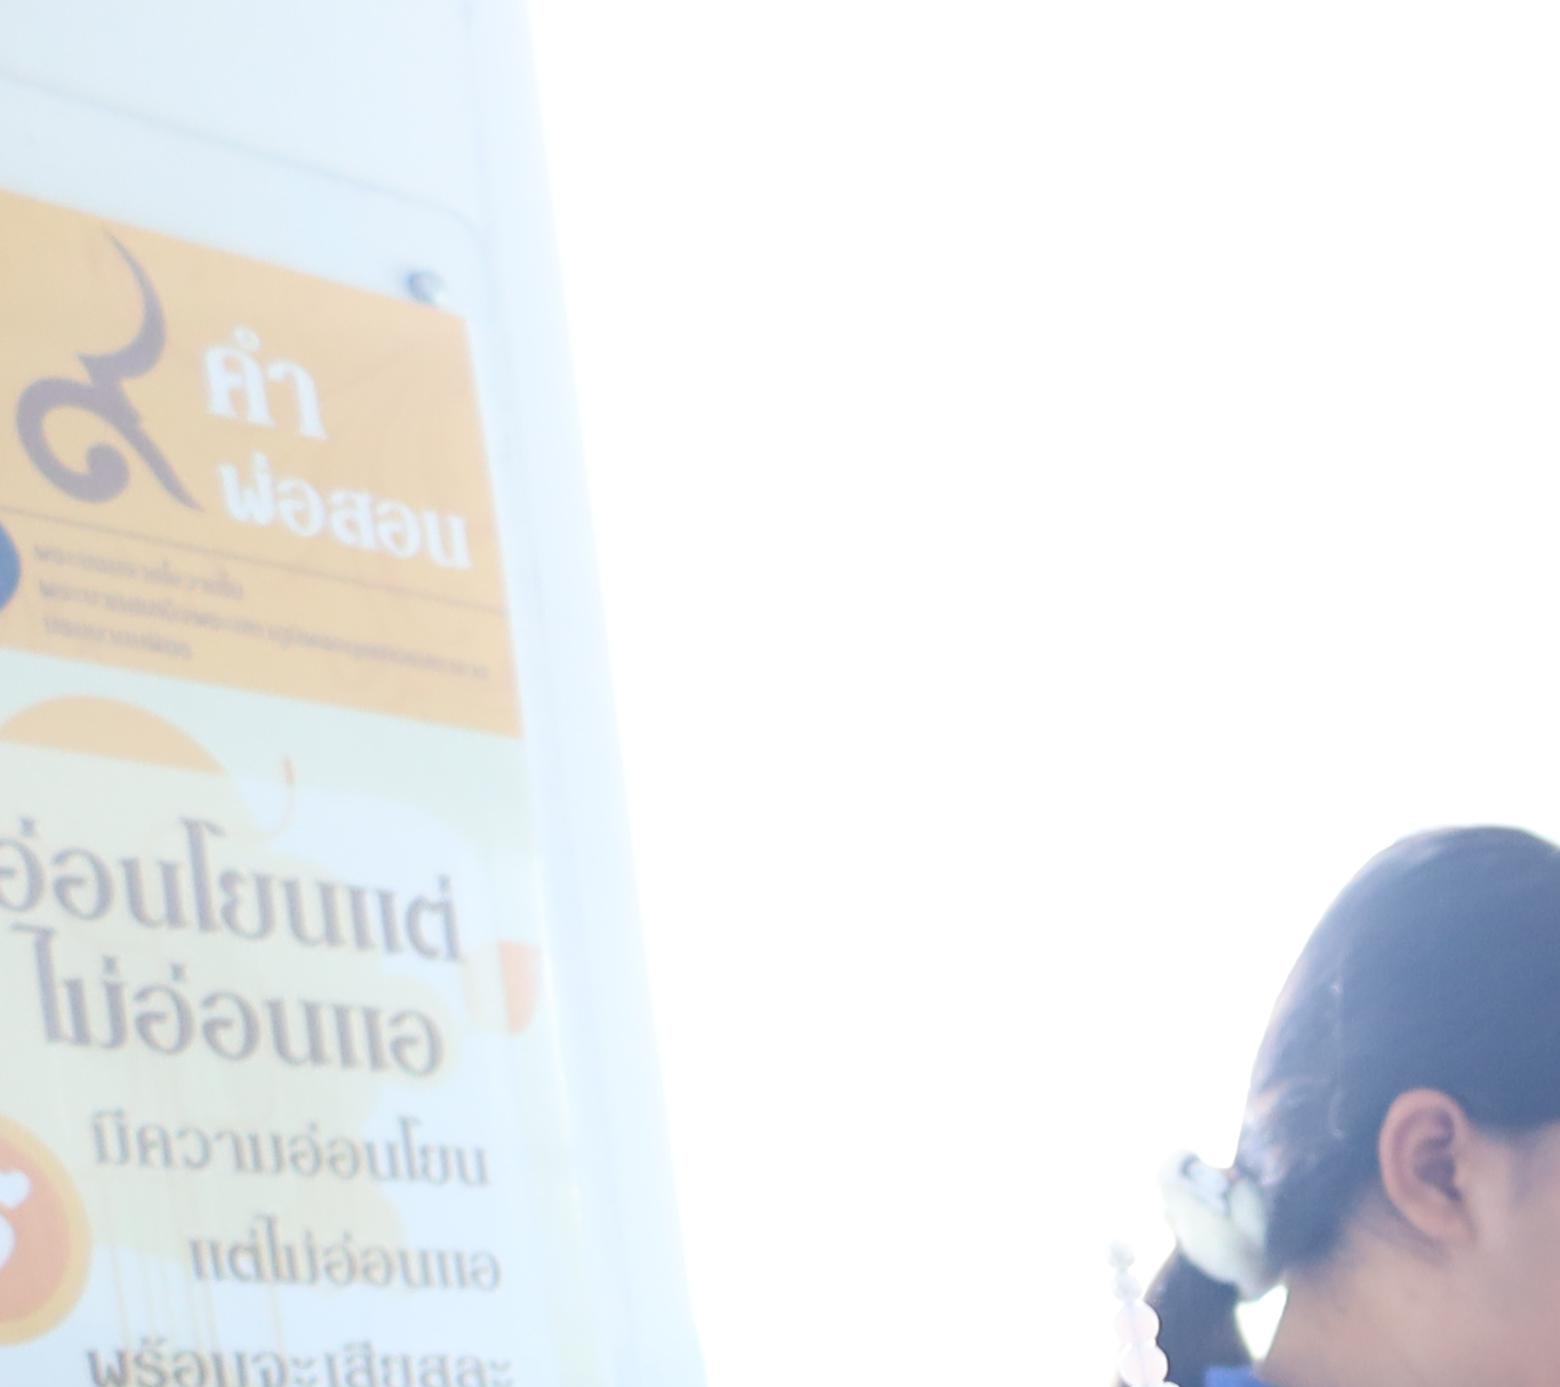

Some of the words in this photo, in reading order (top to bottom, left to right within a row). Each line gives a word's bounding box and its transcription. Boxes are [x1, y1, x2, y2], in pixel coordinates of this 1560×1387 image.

[199, 324, 329, 440] คำ
[217, 450, 473, 571] พ่อสอน
[9, 922, 445, 1079] ไม่อ่อนแอ
[90, 1108, 492, 1188] มีความอ่อนโยน
[187, 1212, 502, 1291] แต่ไม่อ่อนแอ
